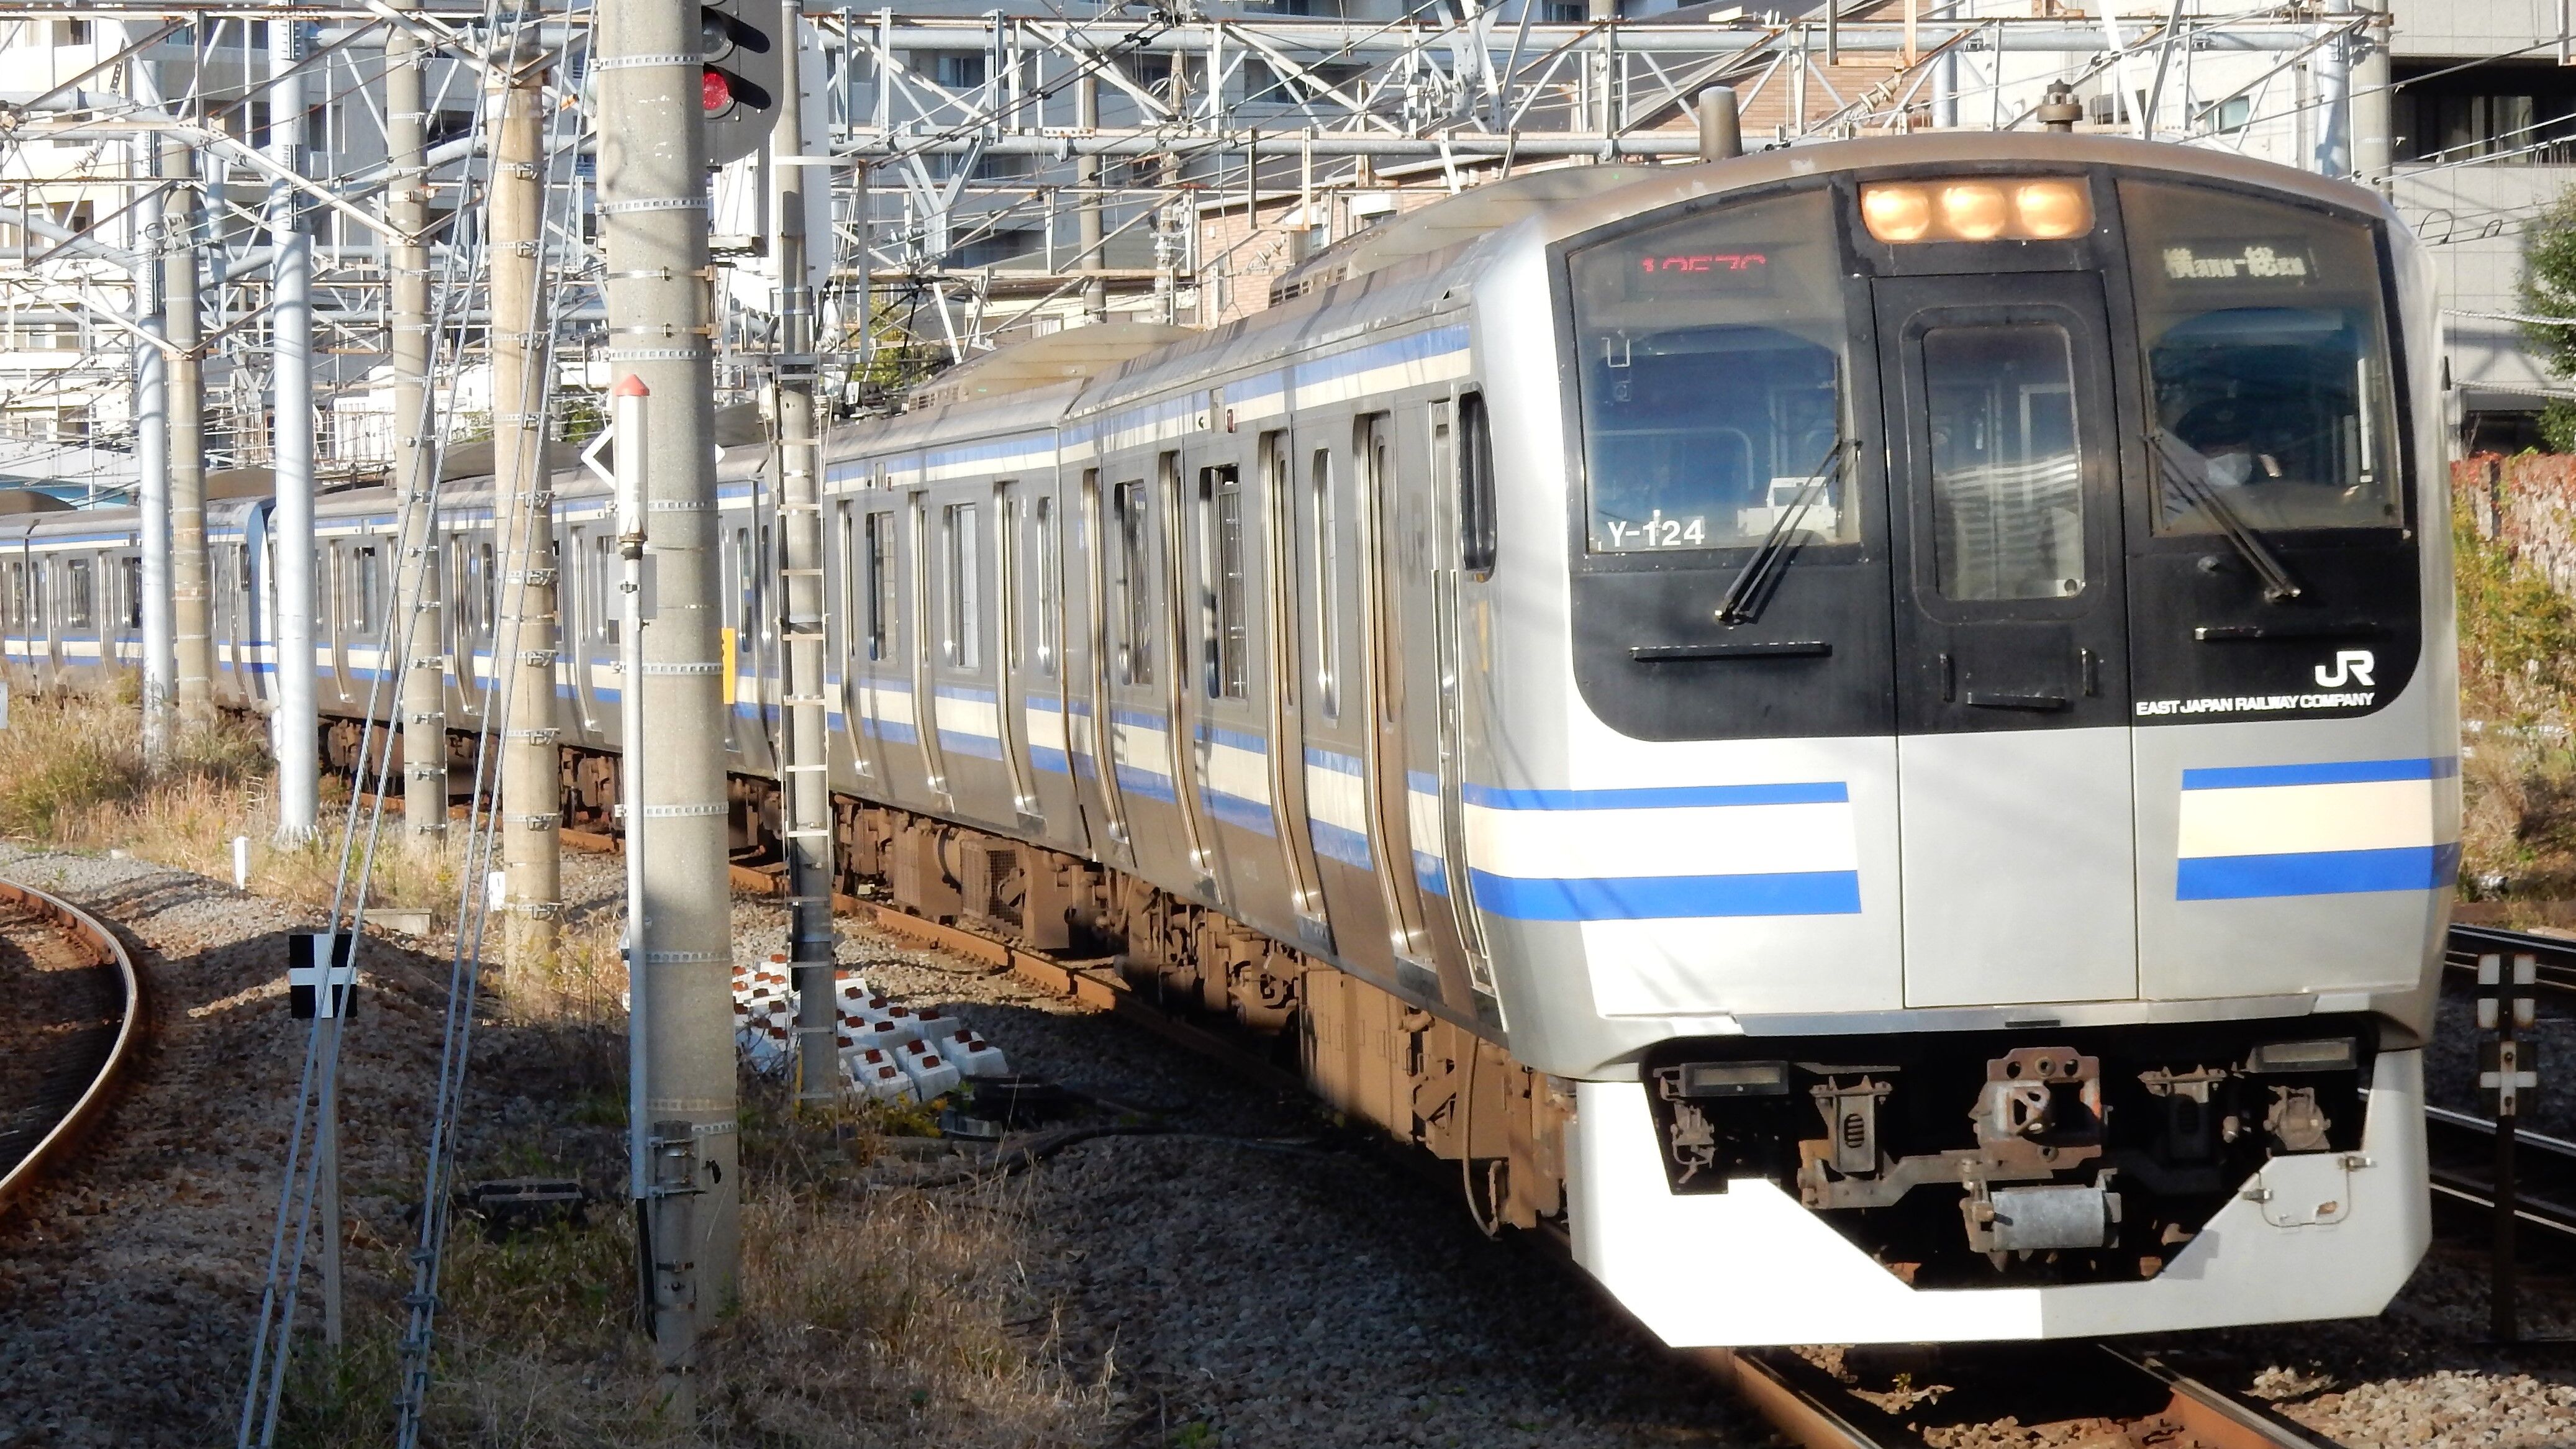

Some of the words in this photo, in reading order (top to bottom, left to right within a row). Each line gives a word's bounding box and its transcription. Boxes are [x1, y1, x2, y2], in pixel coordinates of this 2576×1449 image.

[1607, 519, 1705, 547] Y-124
[2315, 650, 2375, 688] JR
[2136, 700, 2180, 716] EAST
[2180, 697, 2233, 714] JAPAN
[2235, 695, 2299, 711] RAILWAY
[2300, 693, 2375, 709] COMPANY
